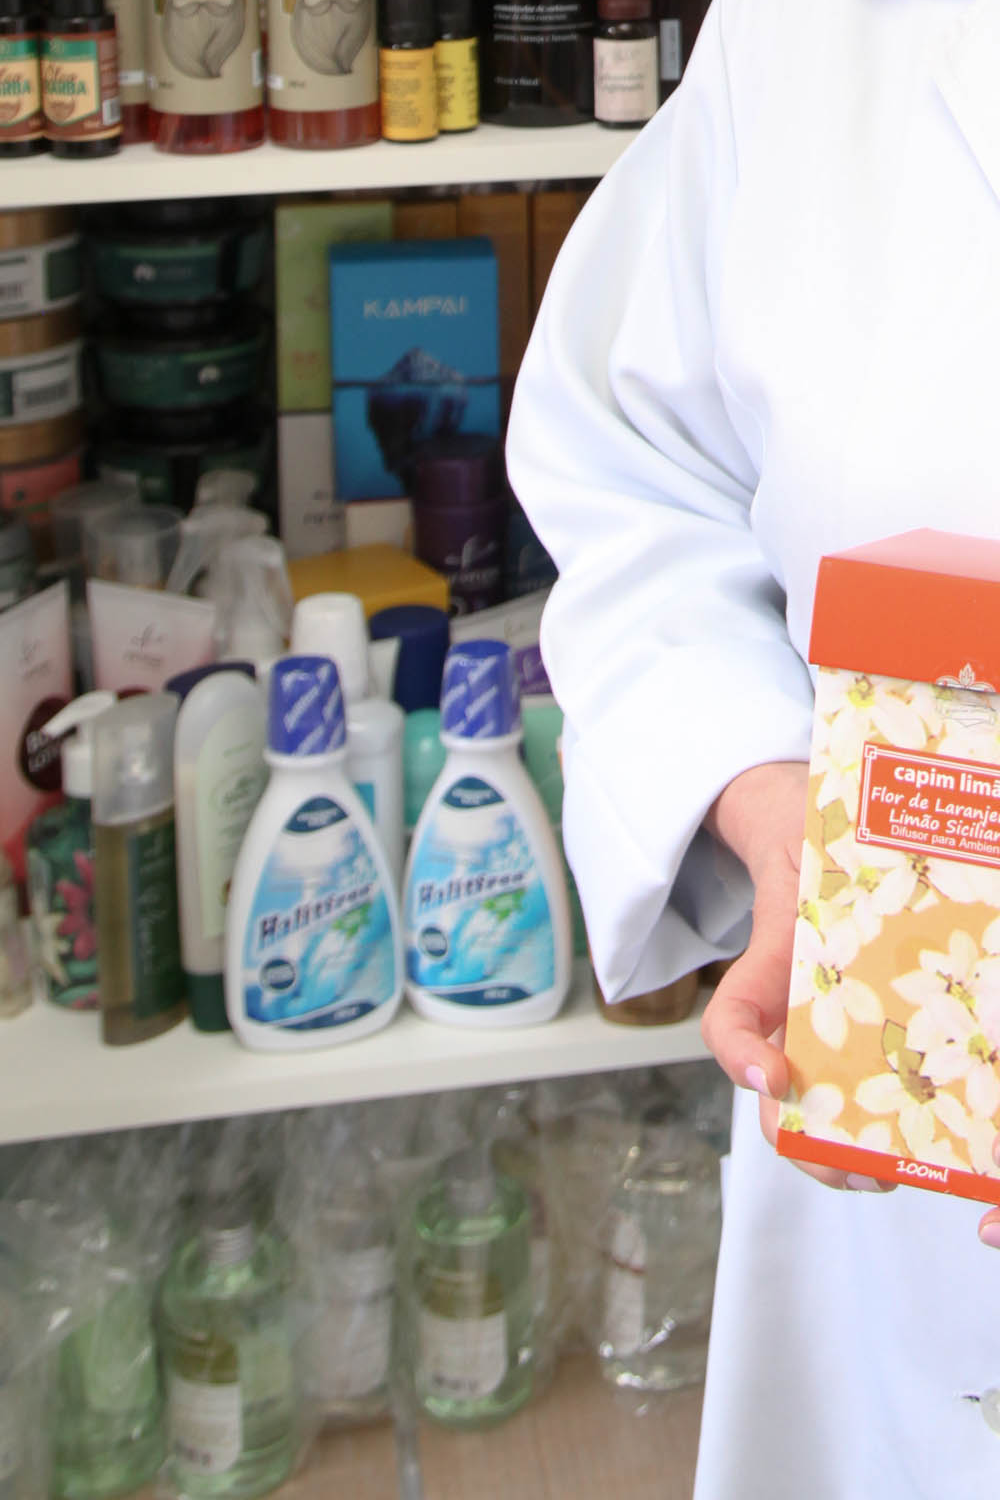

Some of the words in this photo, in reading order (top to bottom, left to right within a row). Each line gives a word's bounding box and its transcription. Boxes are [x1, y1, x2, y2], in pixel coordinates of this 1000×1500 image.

[363, 295, 468, 320] KAMPAI
[893, 766, 955, 791] capim
[871, 786, 904, 805] Flor
[908, 794, 929, 810] de
[889, 809, 940, 831] Limão
[890, 825, 929, 842] Difusor
[931, 831, 956, 848] para
[895, 1160, 949, 1183] 100ml
